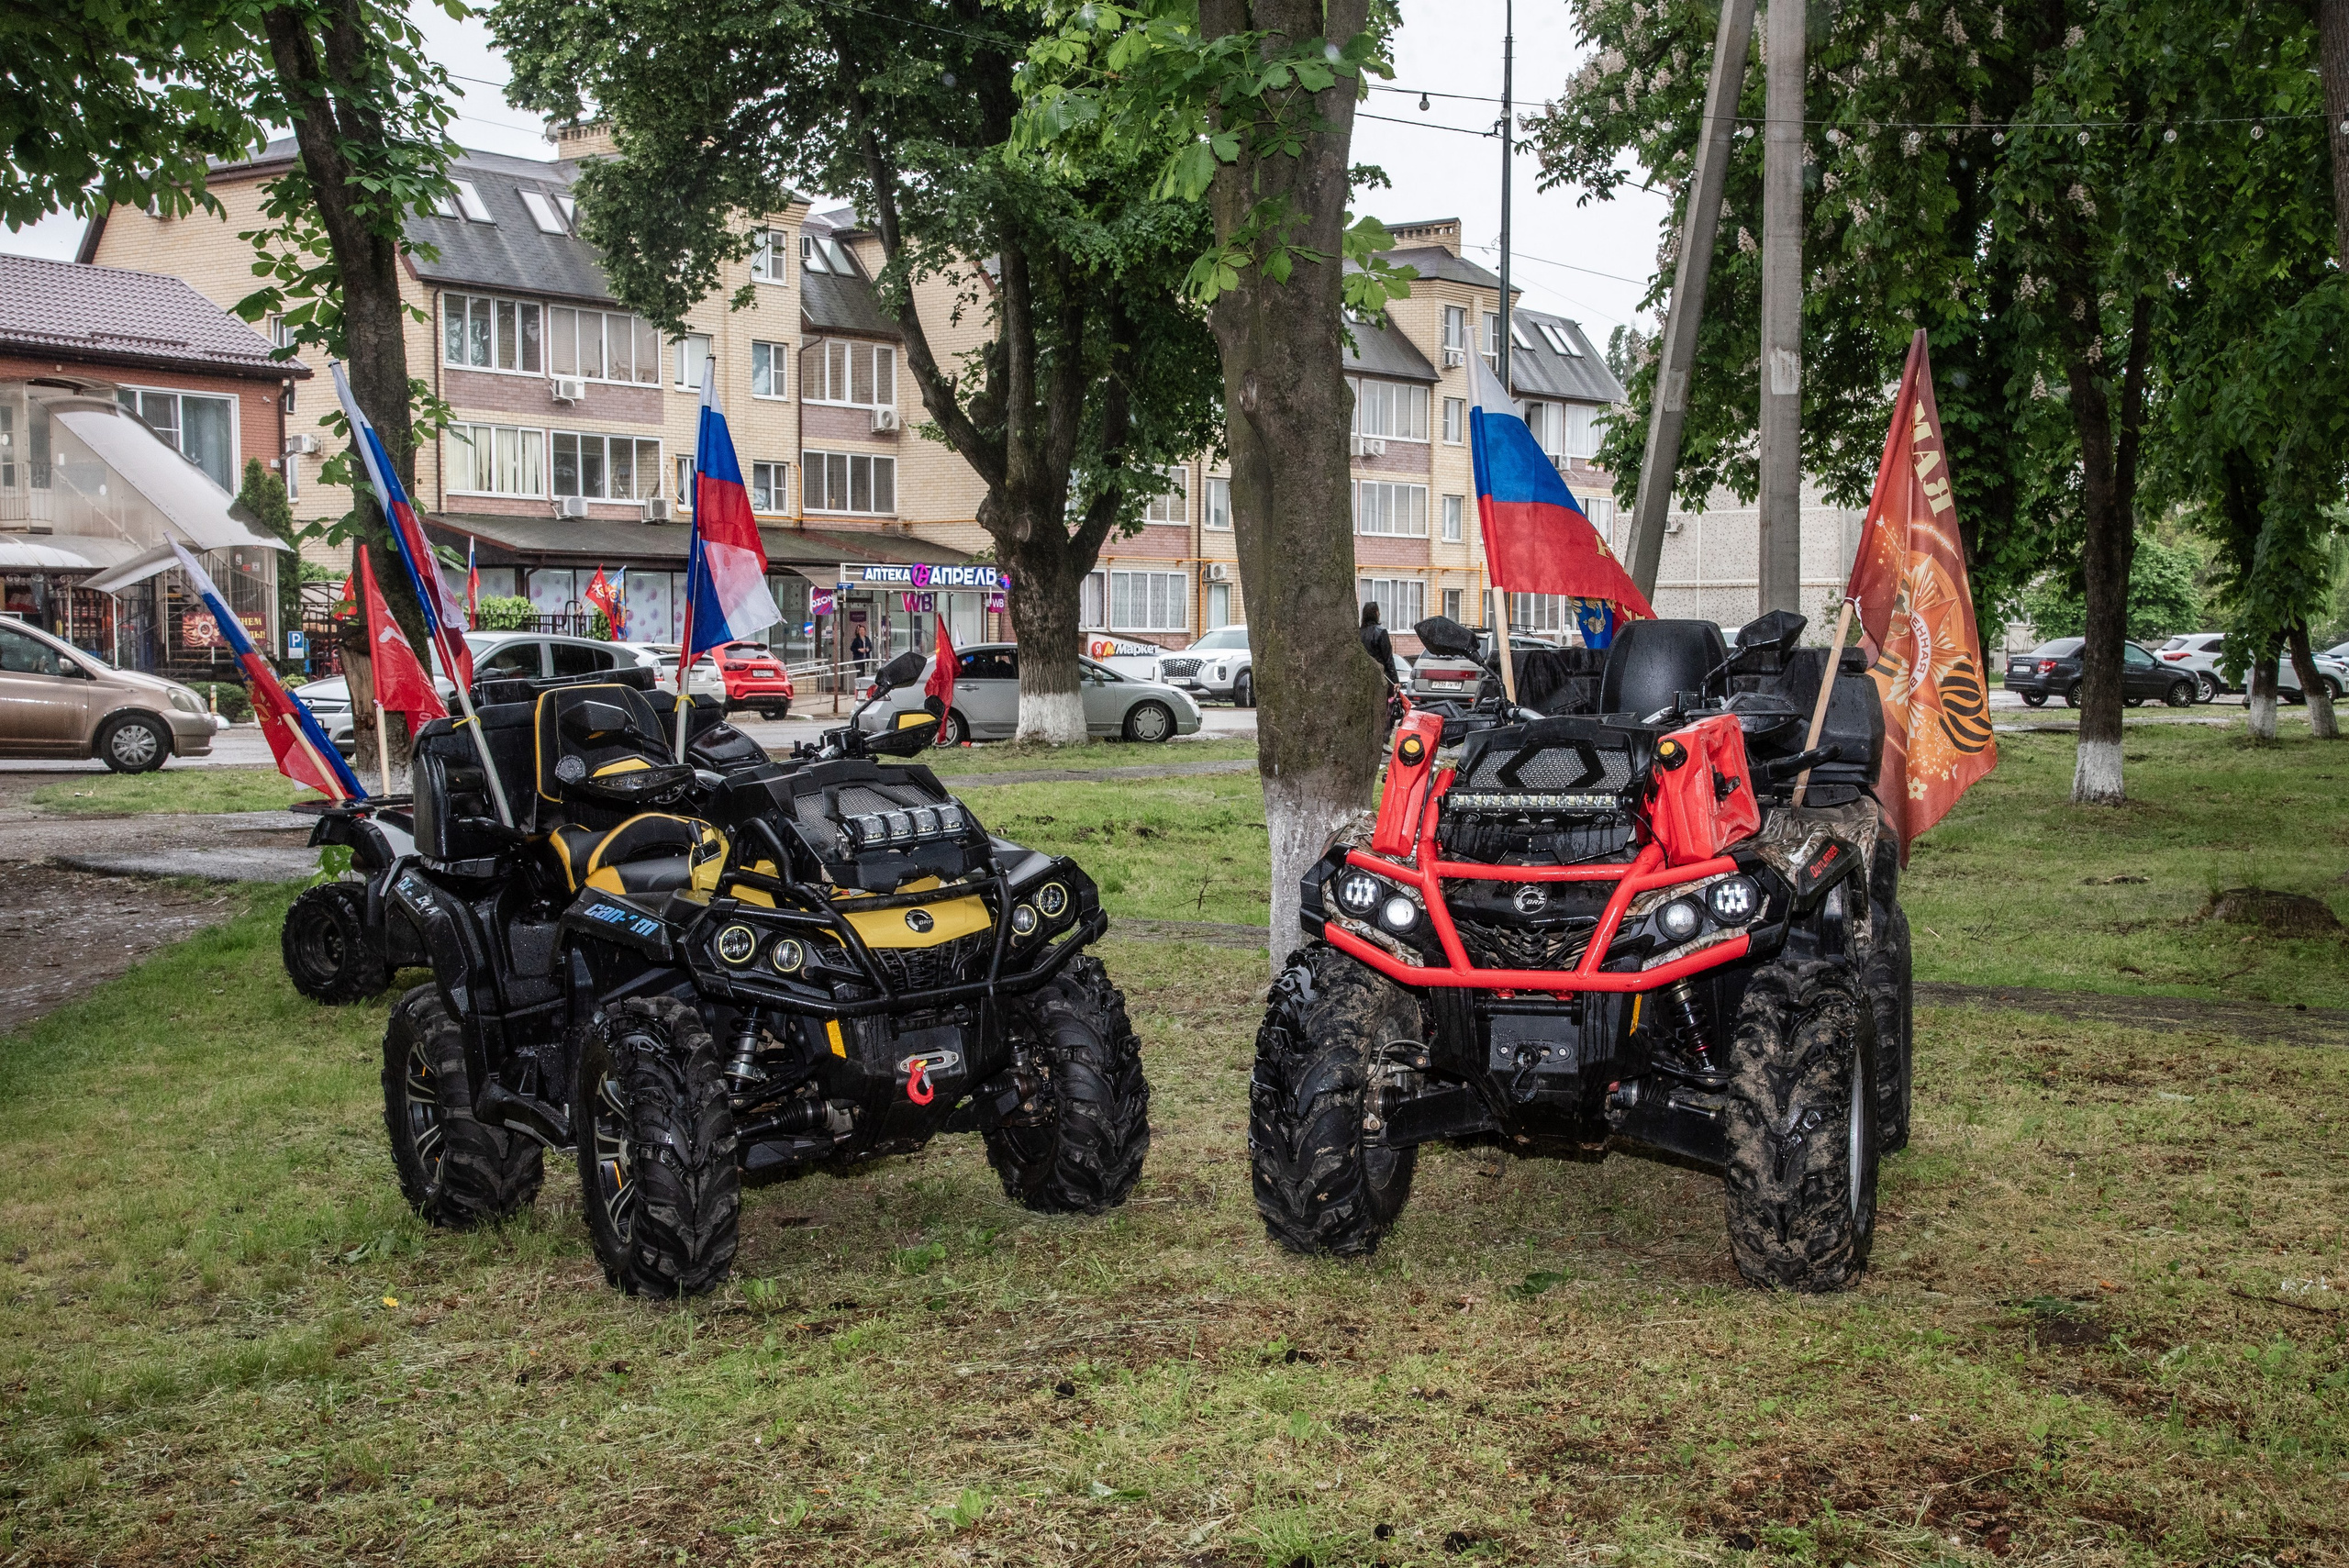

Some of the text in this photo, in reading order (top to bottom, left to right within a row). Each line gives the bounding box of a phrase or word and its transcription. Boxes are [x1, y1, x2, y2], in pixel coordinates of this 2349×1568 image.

[863, 567, 911, 581] АПТЕКА
[929, 566, 997, 585] АПРЕЛЬ
[901, 592, 933, 612] WB
[991, 598, 1004, 608] WB
[239, 617, 262, 626] НЕМ
[292, 633, 301, 647] P
[1909, 611, 1929, 673] ЕННАЯ
[1116, 643, 1160, 656] Маркет
[1809, 844, 1840, 879] OUTLANDER
